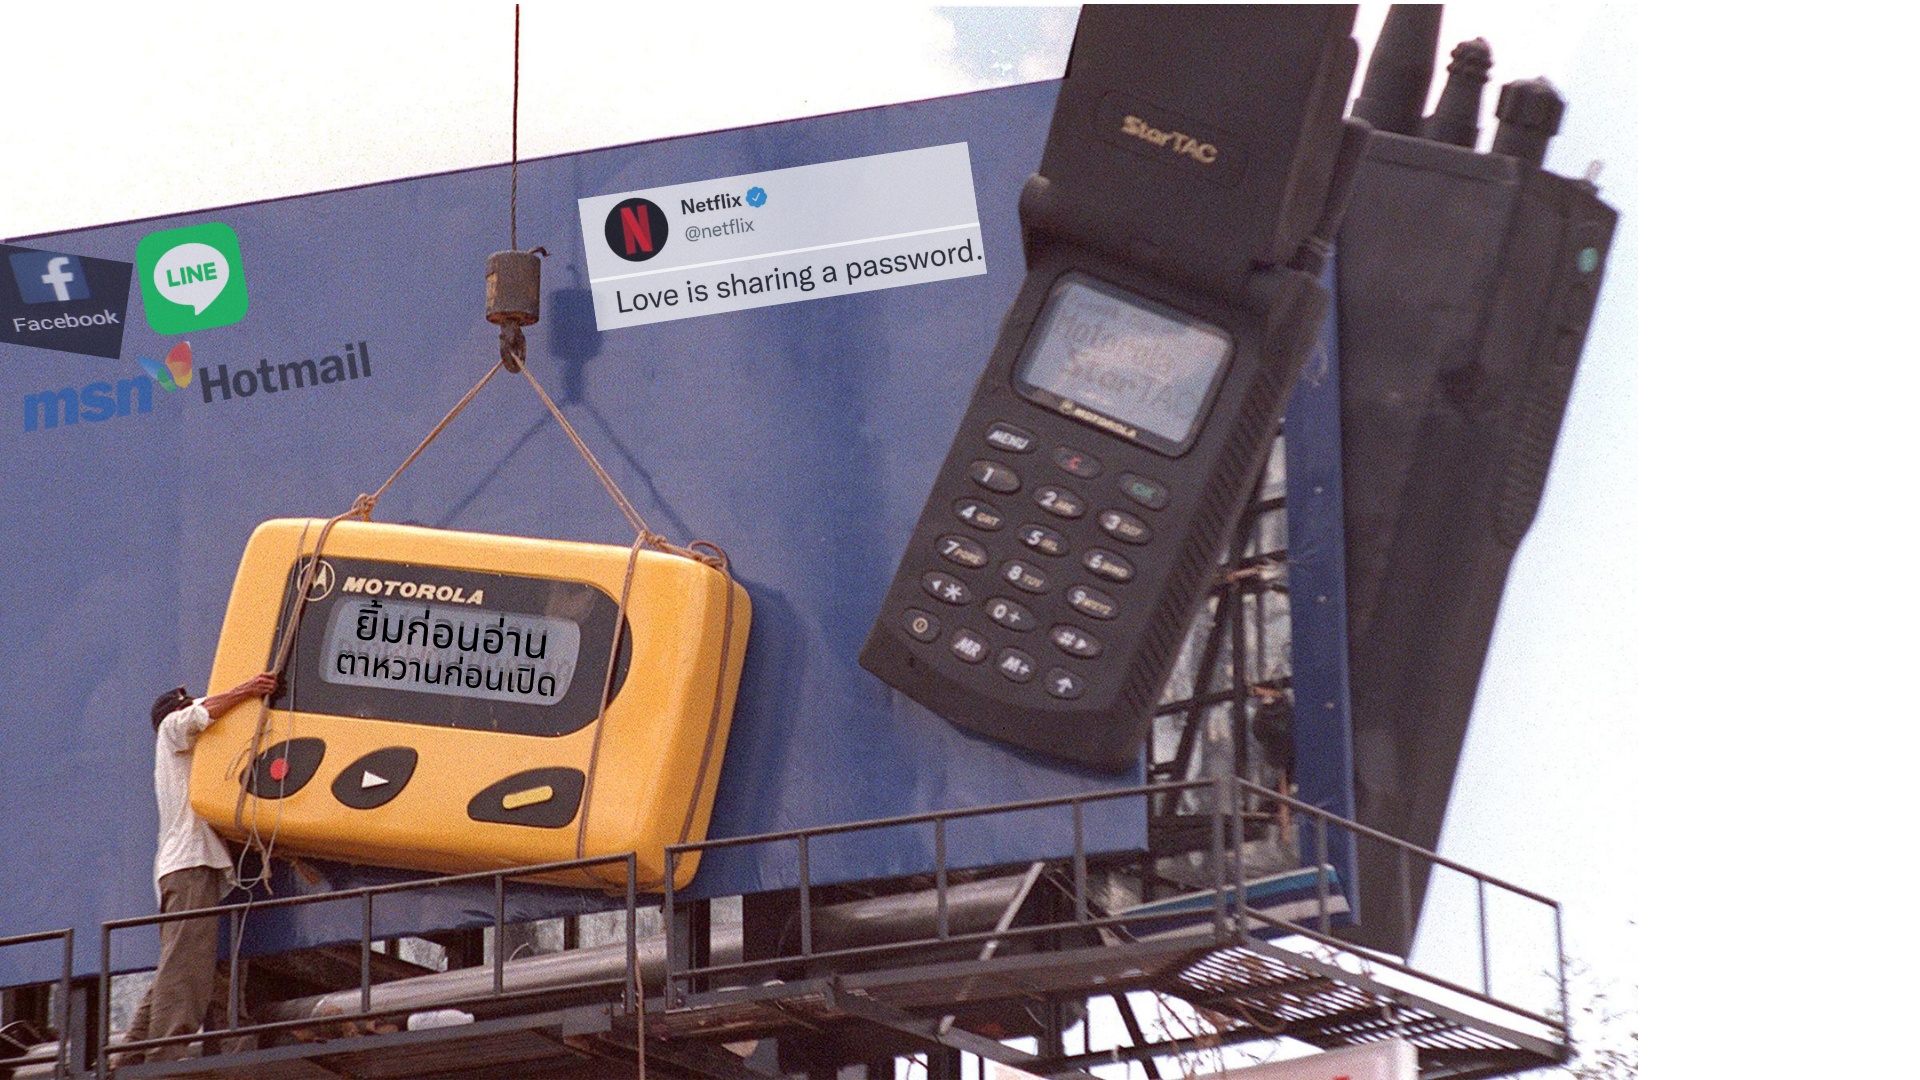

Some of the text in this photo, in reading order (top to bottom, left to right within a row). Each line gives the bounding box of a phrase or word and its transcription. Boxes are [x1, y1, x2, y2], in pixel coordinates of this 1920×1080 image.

[1121, 115, 1218, 163] StarTAC
[989, 430, 1029, 450] MENU
[982, 467, 995, 483] 1
[1040, 491, 1058, 507] 2
[961, 505, 978, 519] 4
[1105, 515, 1121, 531] 3
[1026, 530, 1045, 545] 5
[942, 541, 960, 556] 7
[1089, 555, 1104, 569] 6
[1007, 565, 1023, 581] 8
[342, 576, 484, 605] MOTOROLA
[1073, 590, 1087, 606] 9
[954, 637, 983, 658] MR
